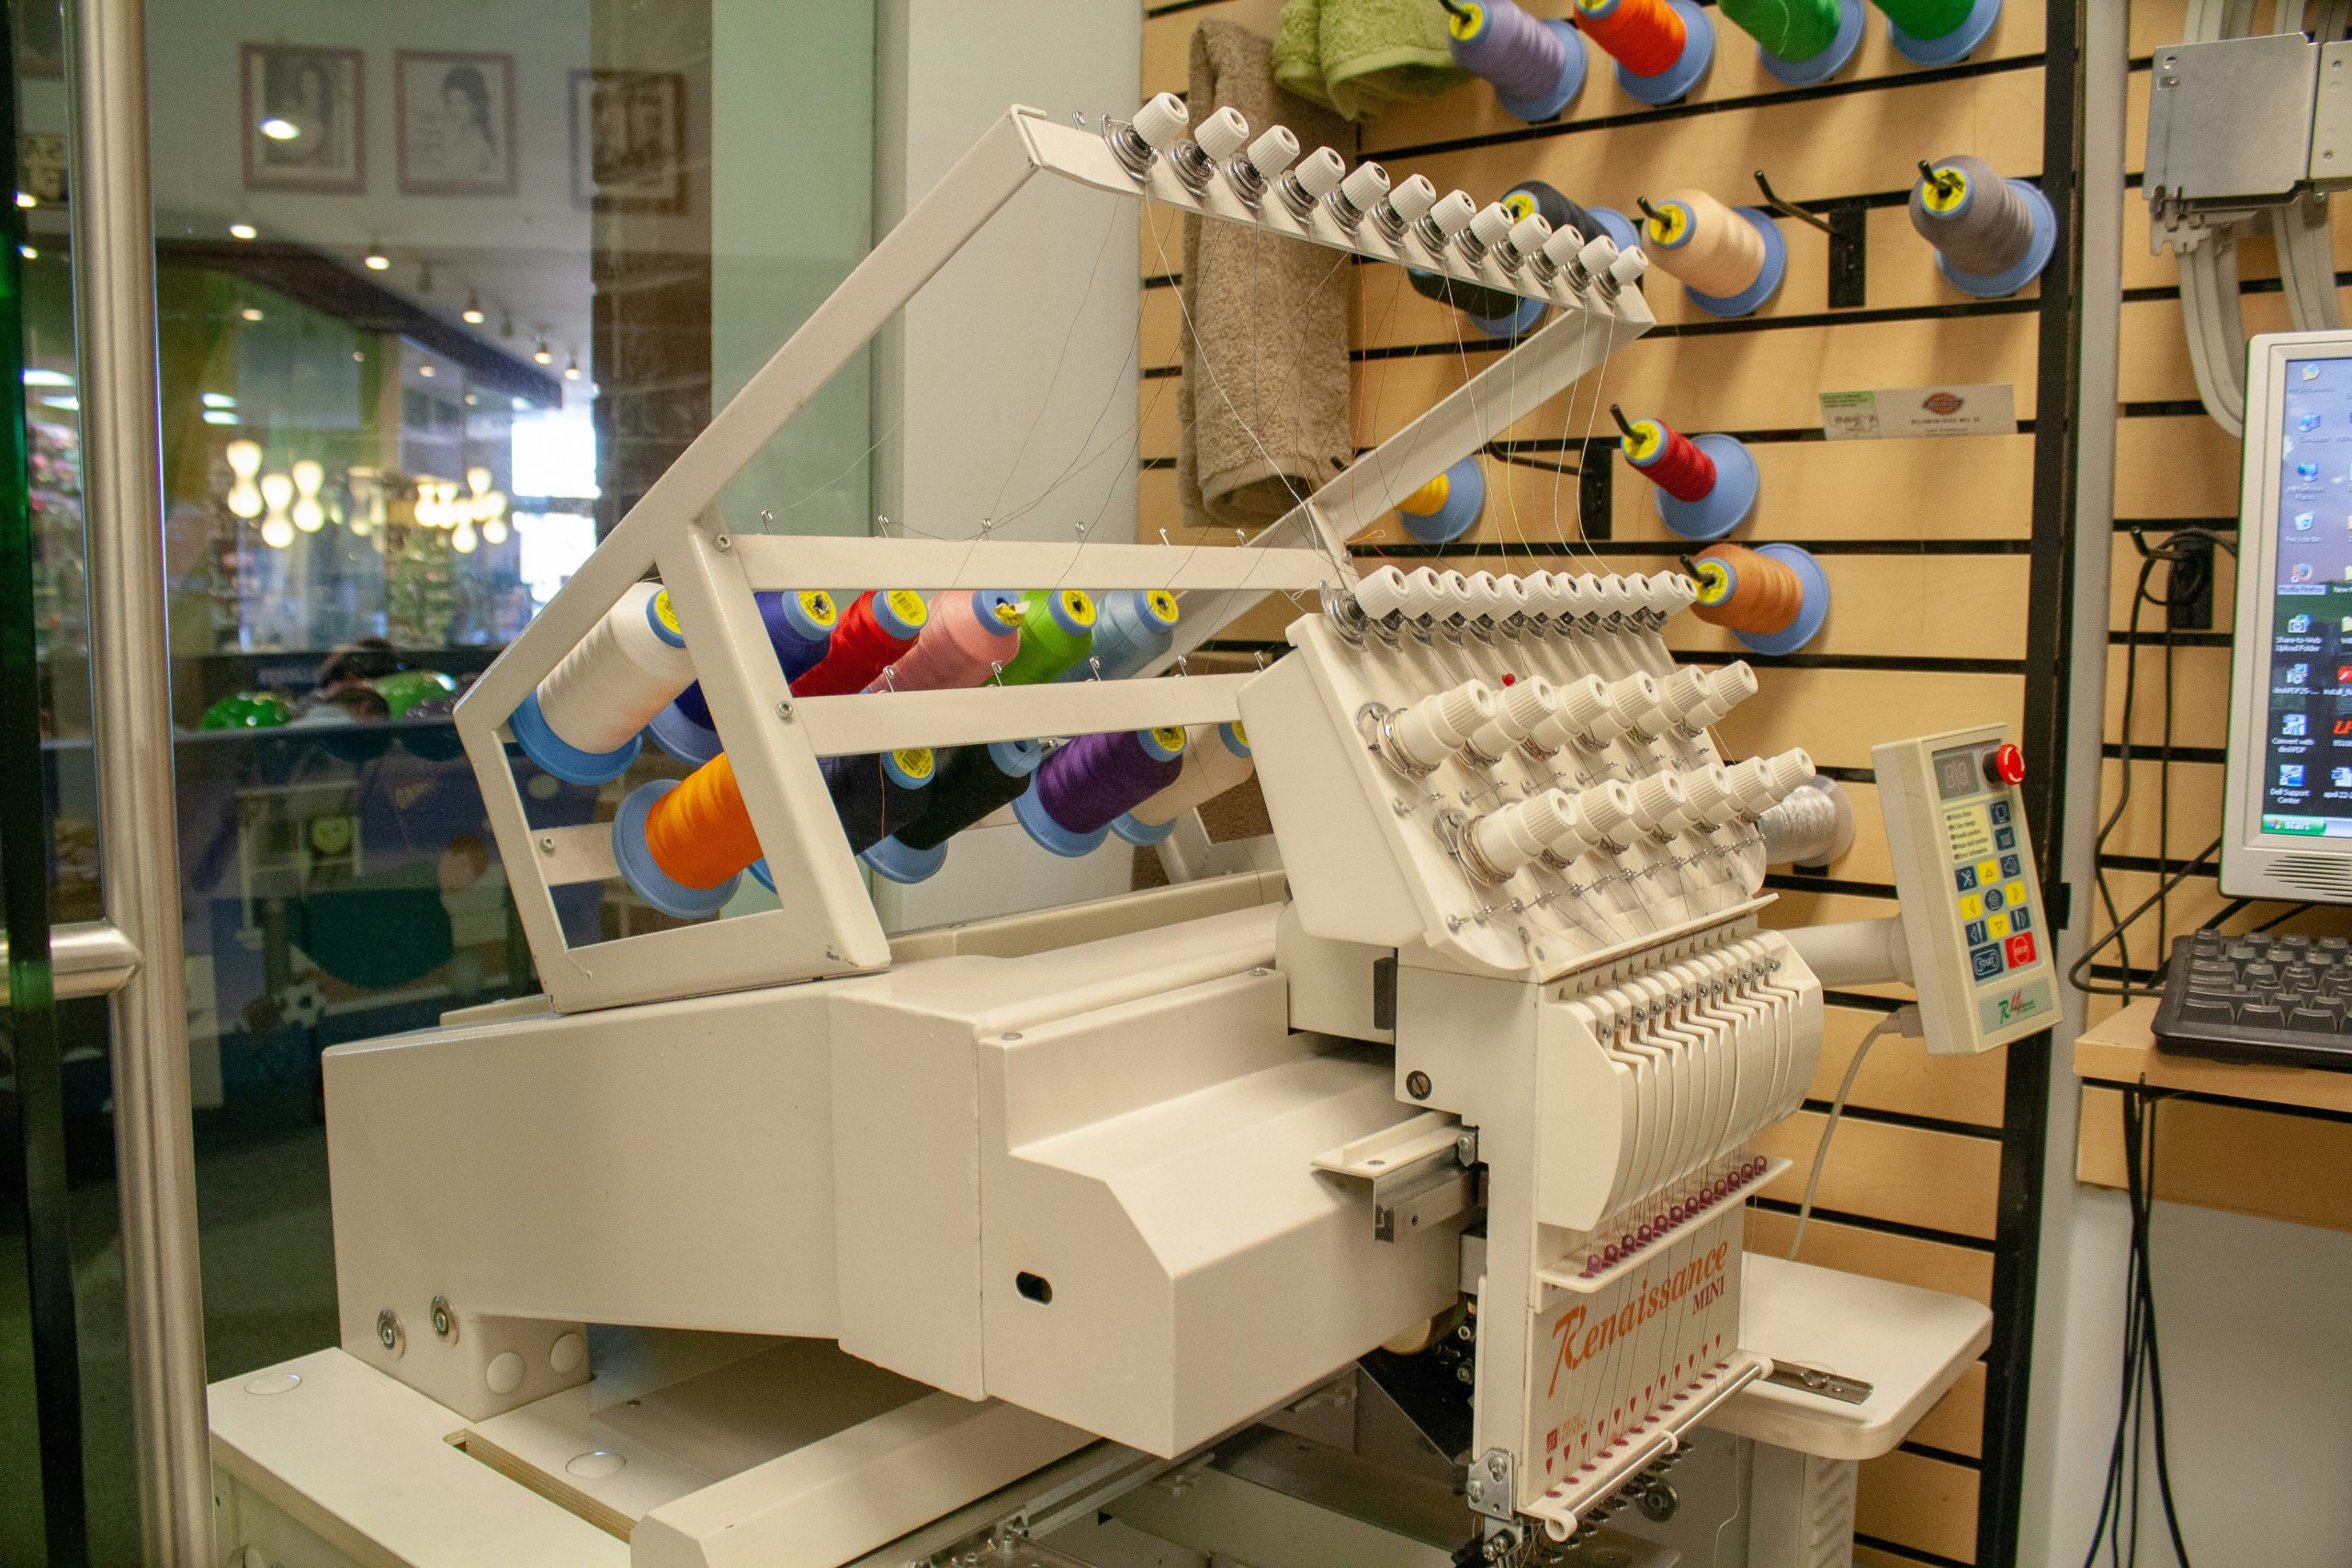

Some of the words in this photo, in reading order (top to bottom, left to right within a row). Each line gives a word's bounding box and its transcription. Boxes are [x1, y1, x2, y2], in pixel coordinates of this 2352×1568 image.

[2285, 536, 2310, 544] Recycle
[2276, 645, 2300, 653] Upload
[2272, 738, 2299, 746] Convert
[2299, 738, 2314, 746] with
[2270, 788, 2282, 796] Dell
[2282, 789, 2311, 797] Support
[2278, 796, 2301, 805] Center
[2284, 821, 2311, 830] start
[1978, 956, 1996, 967] START
[1692, 1275, 1724, 1315] MINI
[1548, 1241, 1728, 1398] Renaissance
